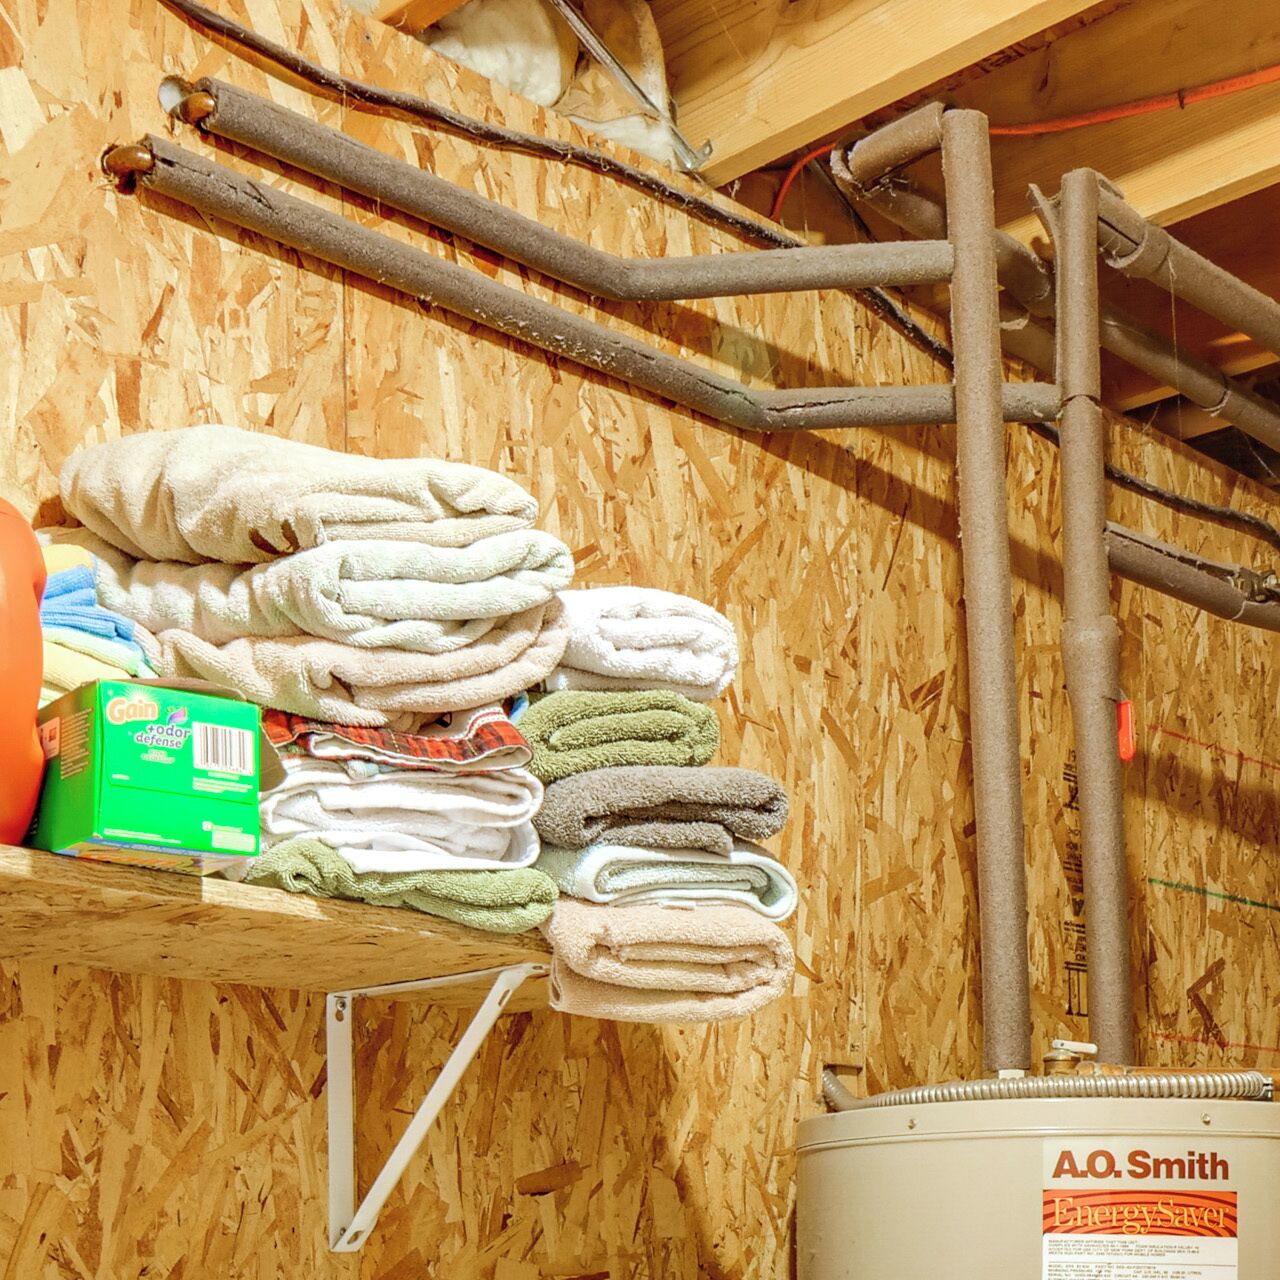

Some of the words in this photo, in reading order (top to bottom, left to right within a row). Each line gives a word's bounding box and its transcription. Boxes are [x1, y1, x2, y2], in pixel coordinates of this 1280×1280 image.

[106, 697, 160, 725] Gain
[135, 732, 183, 749] defense
[1052, 1150, 1122, 1178] A.O.
[1127, 1150, 1229, 1180] Smith
[1053, 1197, 1231, 1235] EnergySaver
